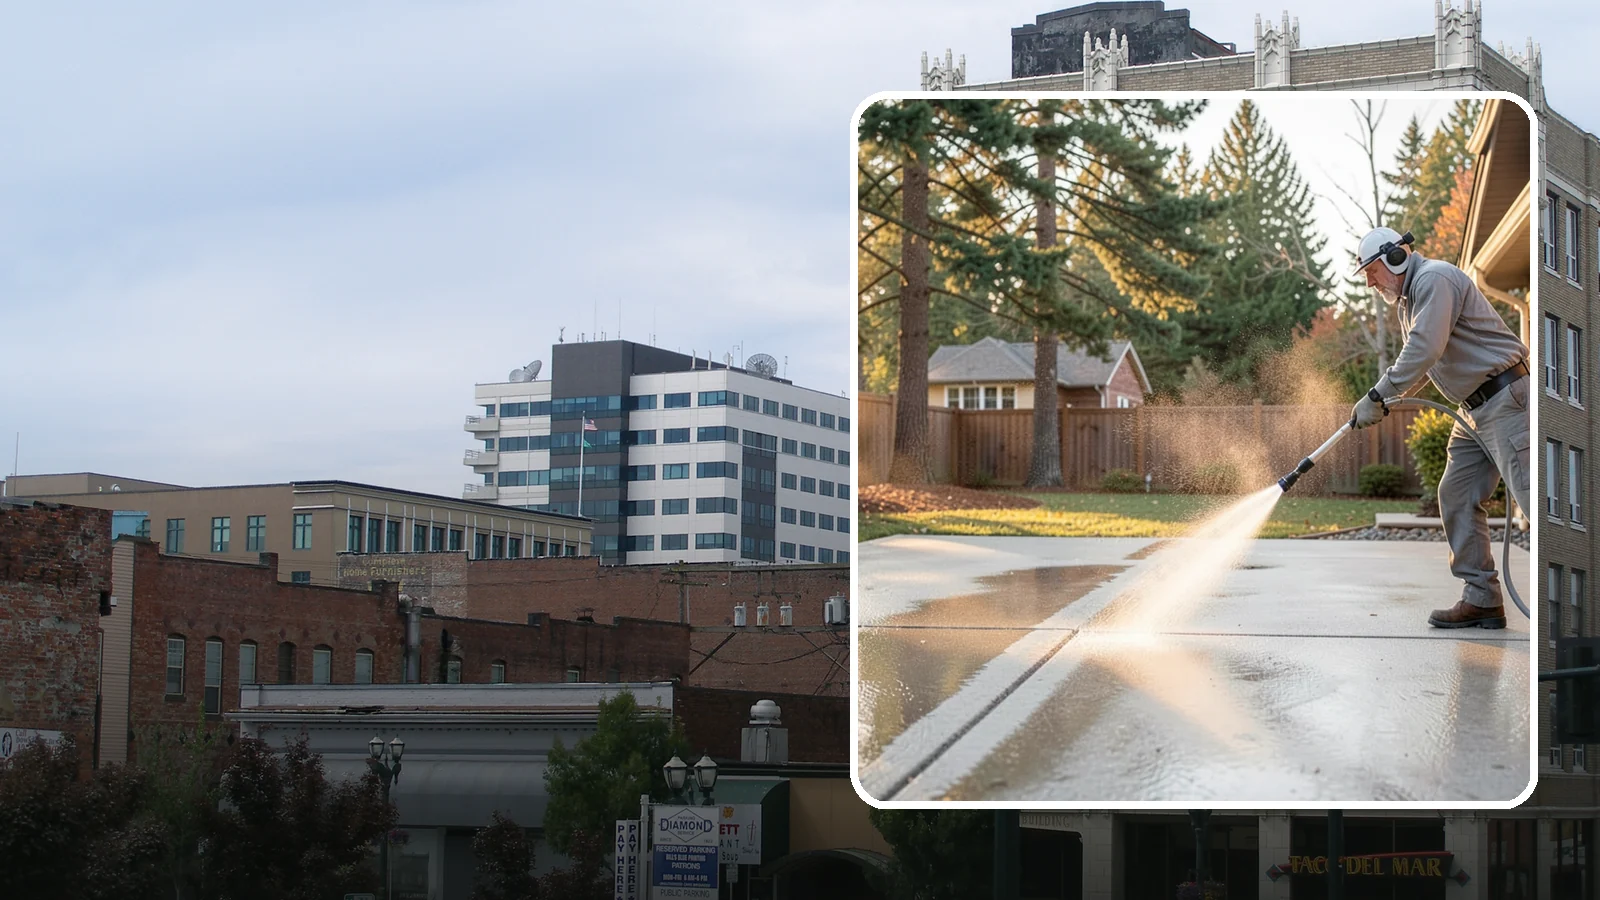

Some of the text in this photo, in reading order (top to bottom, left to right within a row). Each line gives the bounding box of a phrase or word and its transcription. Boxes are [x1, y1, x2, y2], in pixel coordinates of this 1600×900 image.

[370, 566, 427, 576] Furnishers
[660, 818, 713, 833] DIAMOND
[1022, 815, 1069, 828] BUILDING
[719, 824, 740, 836] ETT
[655, 845, 716, 854] RESERVED PARKING
[616, 825, 625, 894] PAY HERE
[627, 825, 637, 894] PAY HERE
[721, 851, 739, 863] Soup
[671, 862, 701, 870] PATRONS
[1346, 856, 1385, 875] DEL
[1392, 857, 1442, 877] MAR
[660, 889, 710, 898] PUBLIC PARKING
